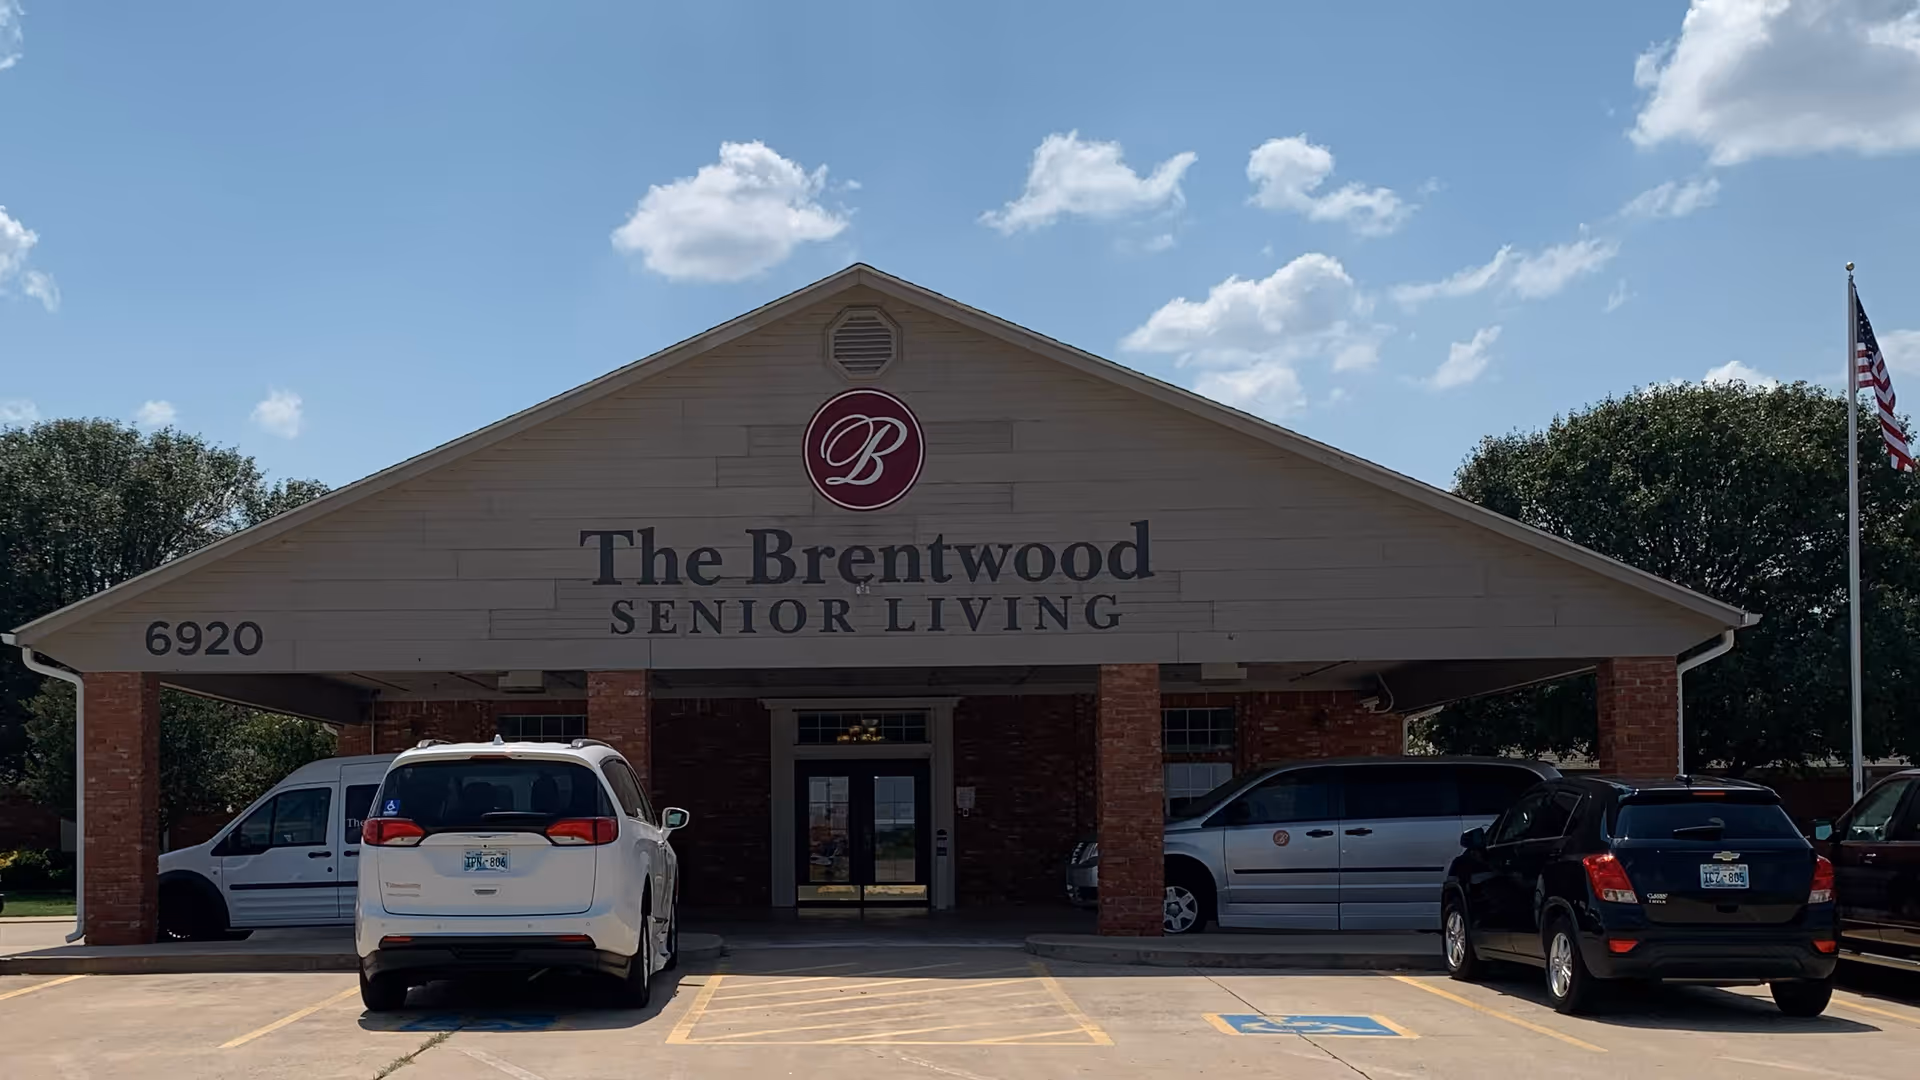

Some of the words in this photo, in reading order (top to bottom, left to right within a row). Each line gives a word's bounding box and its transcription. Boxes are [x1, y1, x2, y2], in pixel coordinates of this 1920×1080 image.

[820, 413, 908, 486] B
[580, 527, 723, 586] The
[745, 519, 1156, 584] Brentwood
[145, 621, 263, 656] 6920
[609, 598, 857, 635] SENIOR
[884, 594, 1123, 632] LIVING
